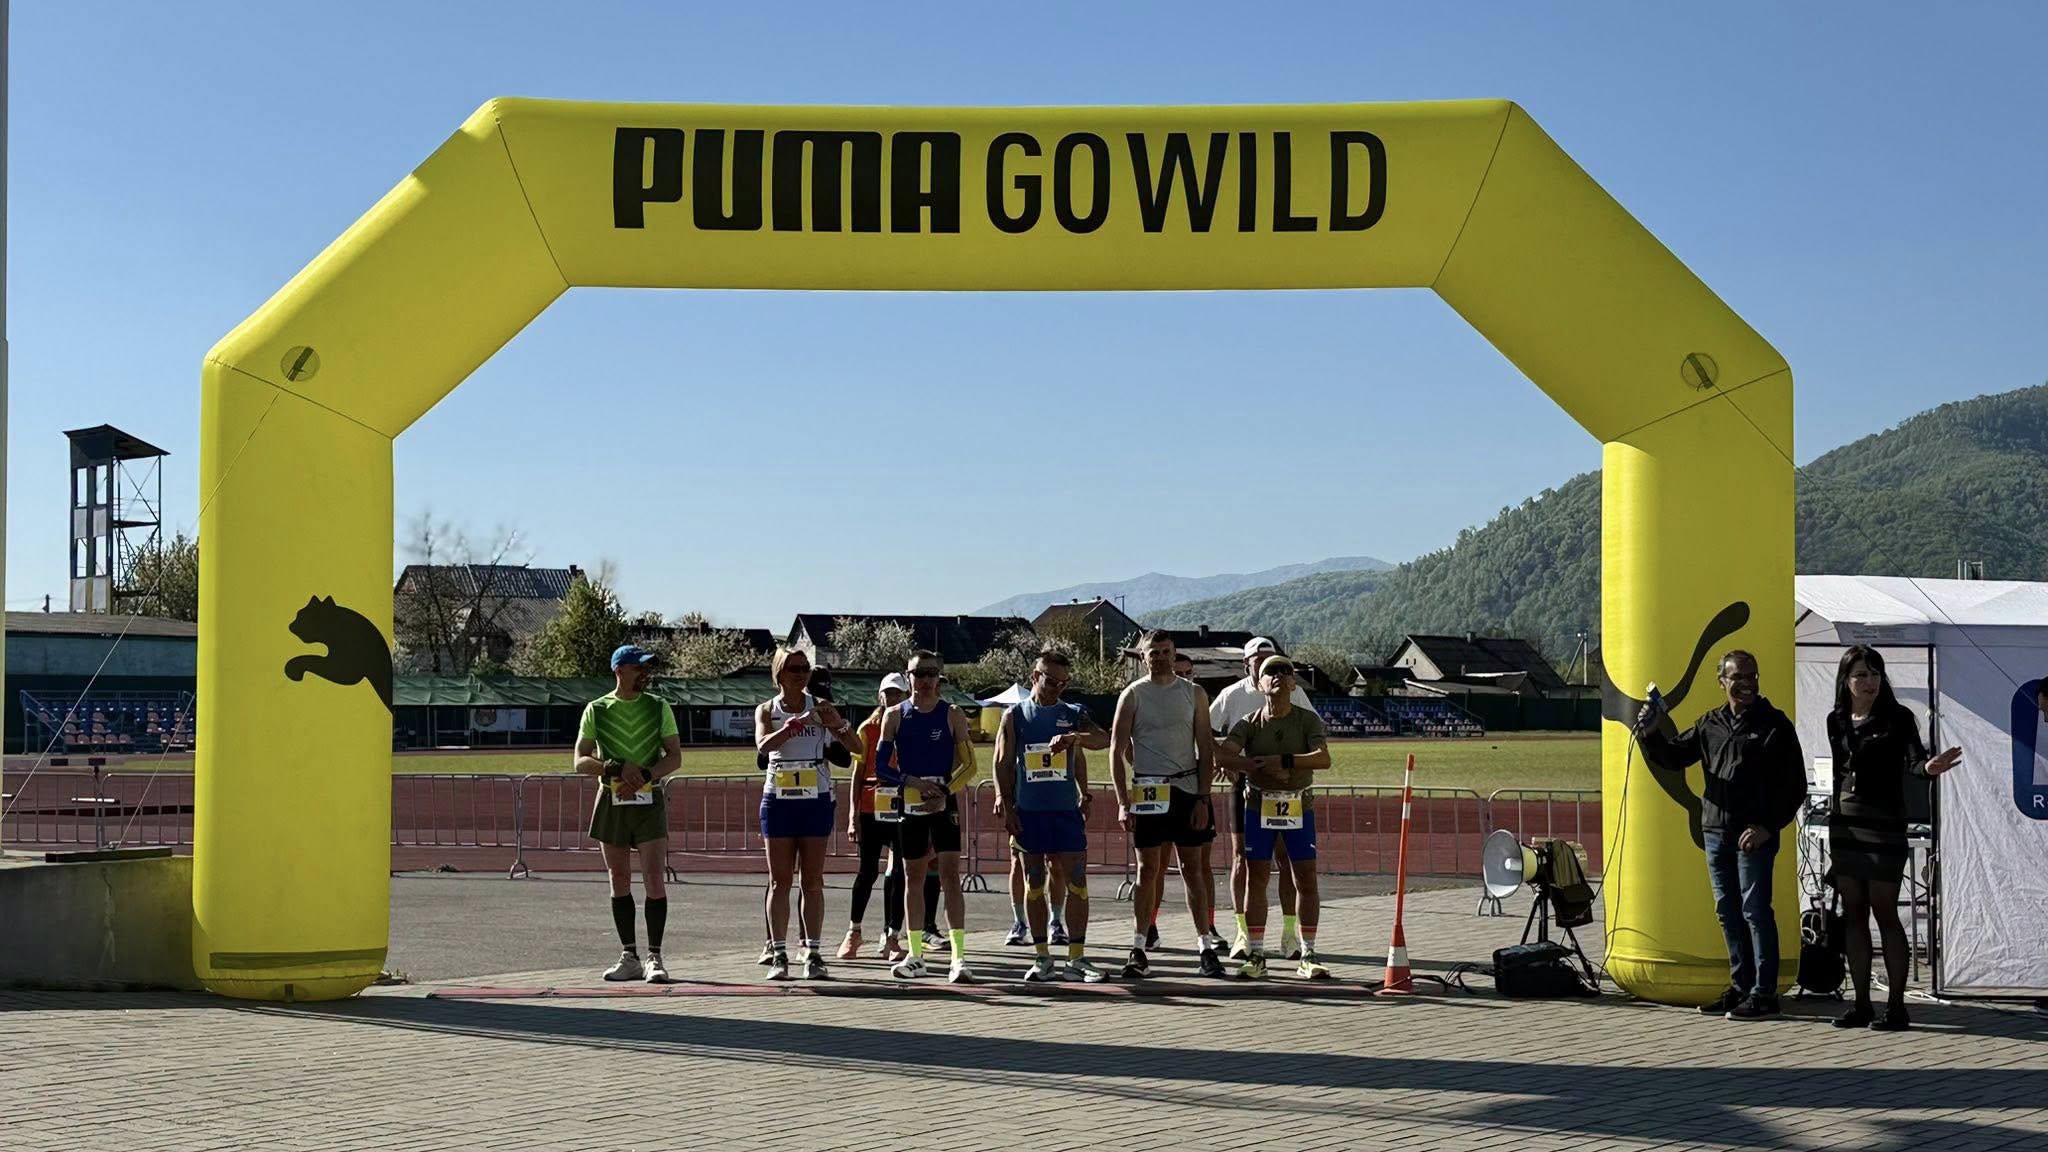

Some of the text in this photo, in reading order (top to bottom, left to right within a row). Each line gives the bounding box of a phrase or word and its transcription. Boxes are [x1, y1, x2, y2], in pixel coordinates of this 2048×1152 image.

[613, 127, 1387, 233] PUMA GO WILD
[1042, 753, 1052, 768] 9
[793, 771, 800, 786] 1
[1143, 787, 1157, 801] 13
[2033, 794, 2048, 809] R
[1275, 801, 1290, 817] 12
